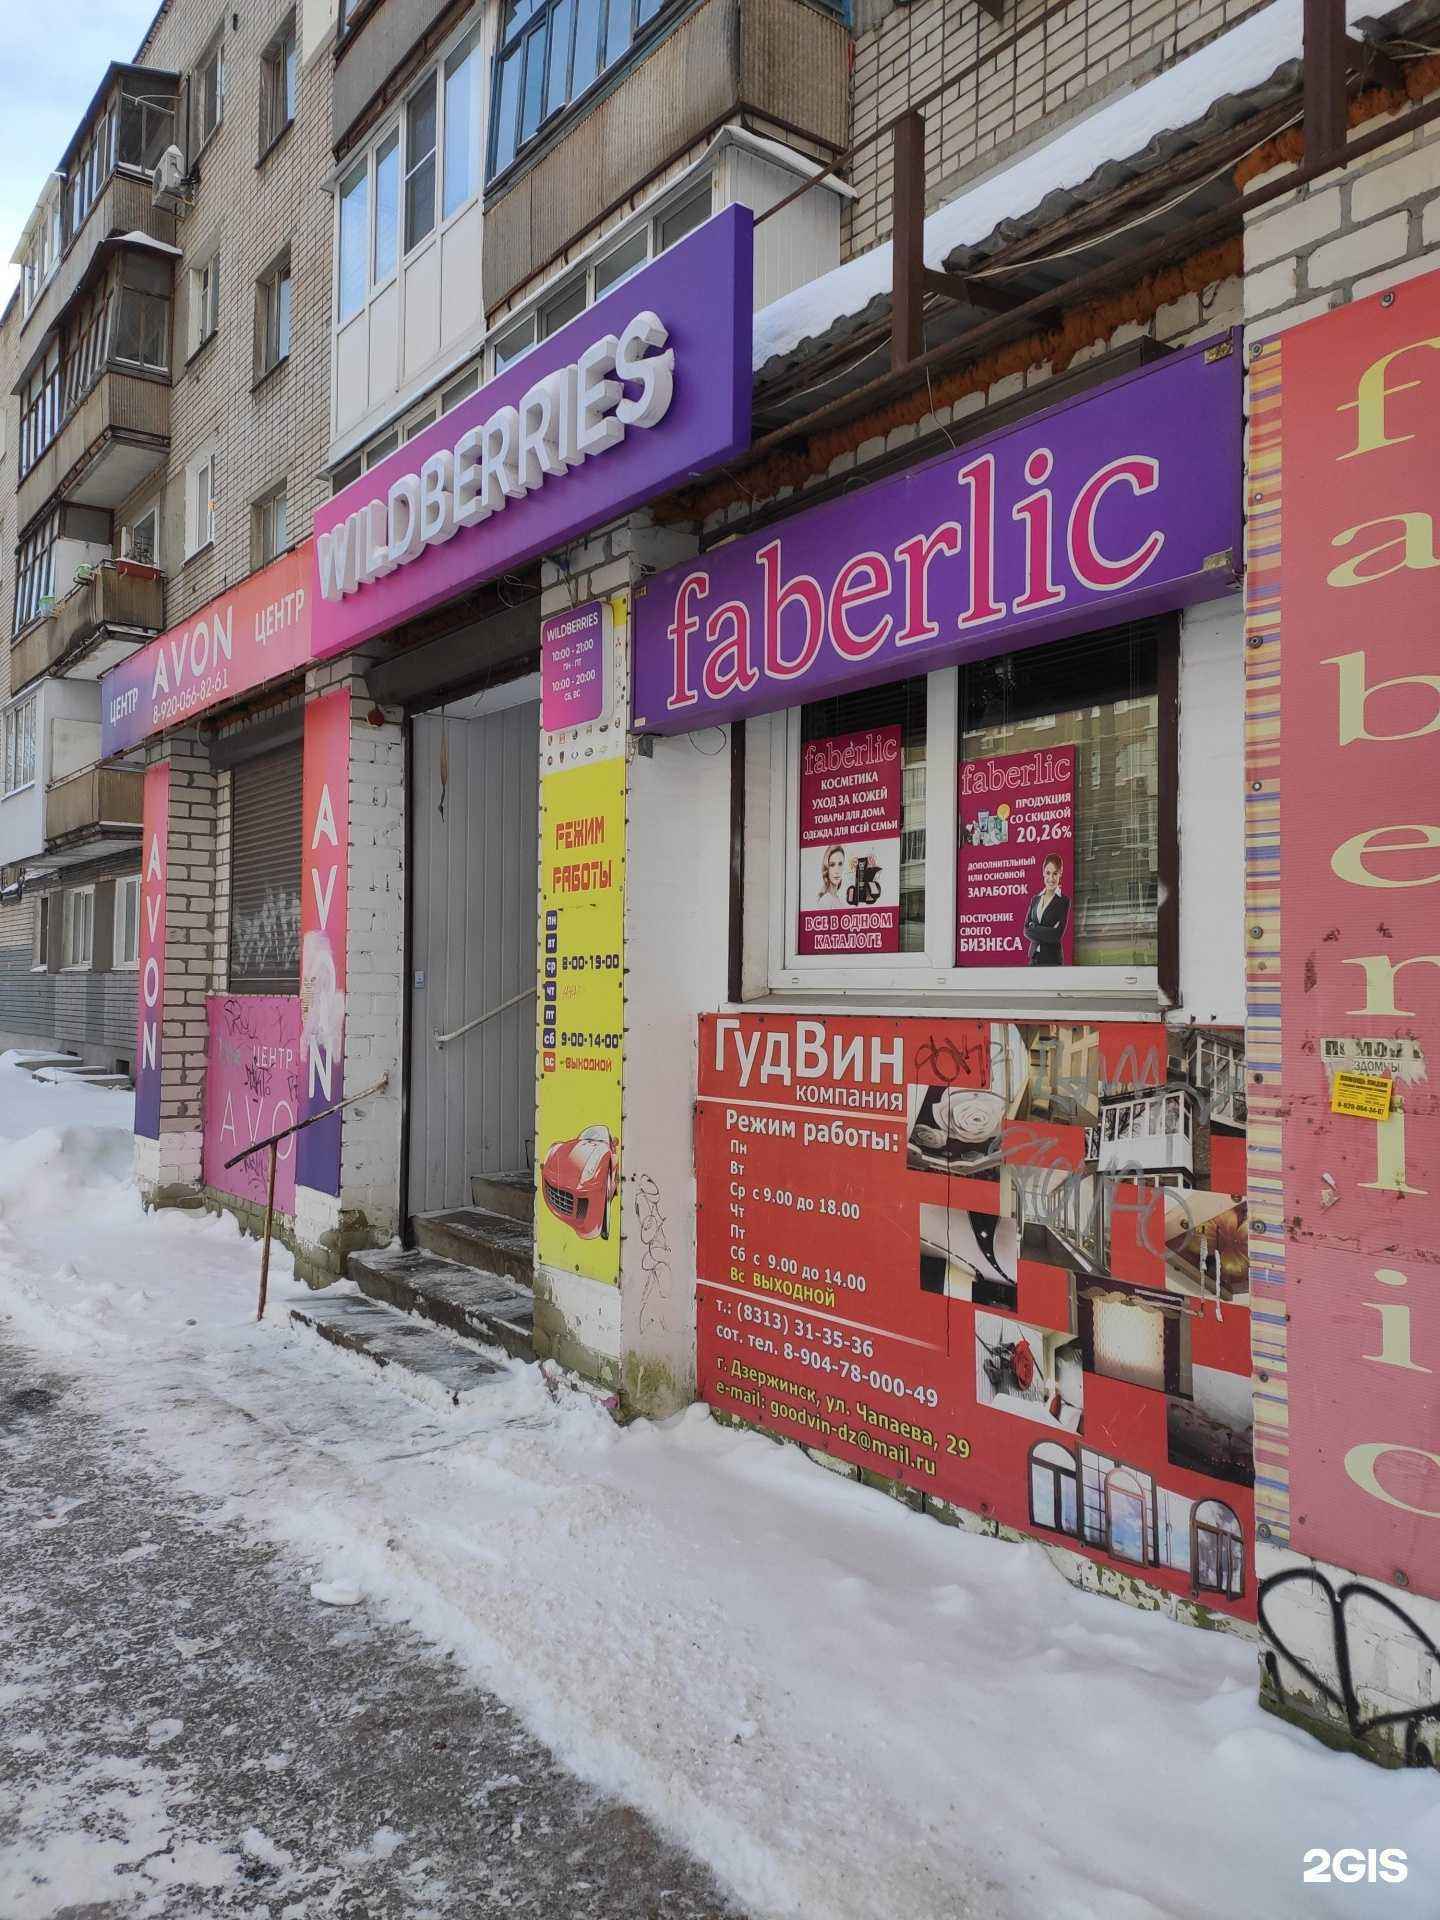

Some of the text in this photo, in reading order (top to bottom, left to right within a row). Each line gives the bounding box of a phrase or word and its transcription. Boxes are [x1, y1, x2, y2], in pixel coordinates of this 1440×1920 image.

[316, 310, 675, 602] WILDBERRIES
[666, 446, 1165, 711] faberlic
[255, 588, 305, 645] ЦЕНТР
[546, 612, 599, 642] WILDBERRIES
[152, 605, 233, 700] AVON
[552, 647, 571, 662] 10:00
[576, 638, 594, 655] 21:00
[552, 677, 571, 692] 10:00
[576, 669, 596, 685] 20:00
[110, 687, 139, 727] ЦЕНТР
[804, 733, 897, 775] faberlic
[821, 771, 879, 790] КОСМЕТИКА
[961, 752, 1071, 796] faberlic
[812, 786, 888, 810] УХОД ЗА КОЖЕЙ
[1015, 792, 1071, 809] ПРОДУКЦИЯ
[814, 806, 885, 825] ТОВАРЫ ДЛЯ ДОМА
[1010, 806, 1071, 824] СО СКИДКОЙ
[556, 815, 605, 850] РЕЖИМ
[803, 819, 898, 841] ОДЕЖДА ДЛЯ ВСЕЙ СЕМЬИ
[1016, 822, 1072, 844] 20,26%
[967, 856, 1036, 871] ДОПОЛНИТЕЛЬНЫЙ
[967, 869, 1025, 882] ИЛИ ОСНОВНОЙ
[552, 859, 612, 894] РАБОТЫ
[967, 884, 1028, 898] ЗАРАБОТОК
[805, 912, 893, 932] ВСЕ В ОДНОМ
[960, 912, 1014, 924] ПОСТРОЕНИЕ
[308, 784, 338, 1102] AVN
[814, 932, 882, 949] КАТАЛОГЕ
[960, 926, 992, 936] СВОЕГО
[141, 833, 162, 1071] AVON
[960, 936, 1023, 952] БИЗНЕСА
[796, 1085, 903, 1112] компания
[726, 1109, 899, 1152] Режим работы:
[730, 1139, 747, 1155] Пн
[730, 1161, 744, 1176] Вт
[730, 1182, 860, 1220] Ср с 9.00 до 18.00
[730, 1203, 744, 1218] Чт
[730, 1224, 745, 1240] Пт
[730, 1245, 866, 1292] Сб с 9.00 до 14.00
[730, 1267, 835, 1307] Вс ВЫХОДНОЙ
[737, 1301, 789, 1336] (8313)
[794, 1318, 874, 1358] 31-35-36
[716, 1324, 938, 1408] сот. тел. 8-904-78-000-49
[716, 1356, 972, 1459] г. Дзержинск, ул. Чапаева, 29
[716, 1381, 936, 1476] e-mail: goodvin-dz@mail.ru
